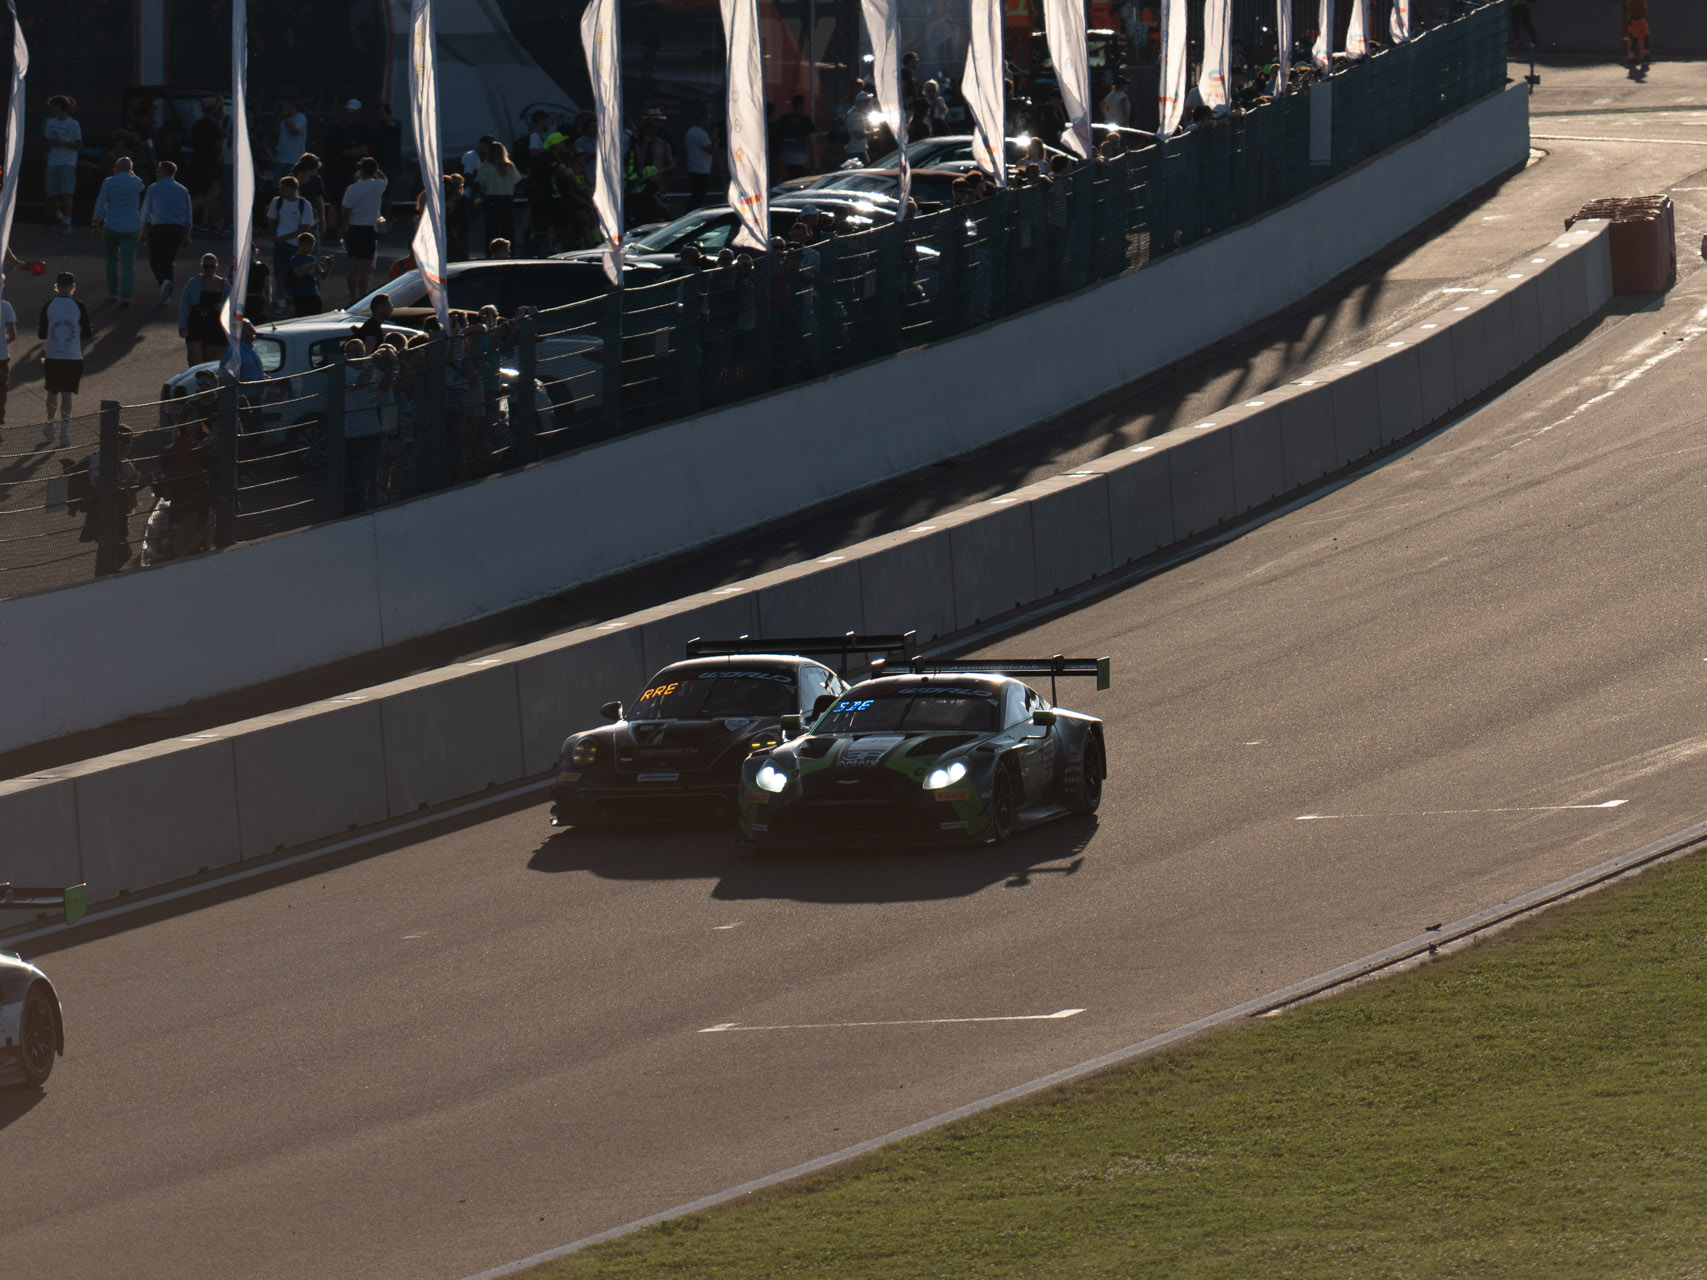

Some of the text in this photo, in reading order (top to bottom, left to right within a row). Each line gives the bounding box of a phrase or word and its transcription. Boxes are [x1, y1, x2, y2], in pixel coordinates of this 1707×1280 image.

[697, 671, 793, 683] WORLD
[640, 682, 679, 702] RRE
[898, 687, 993, 697] WORLD
